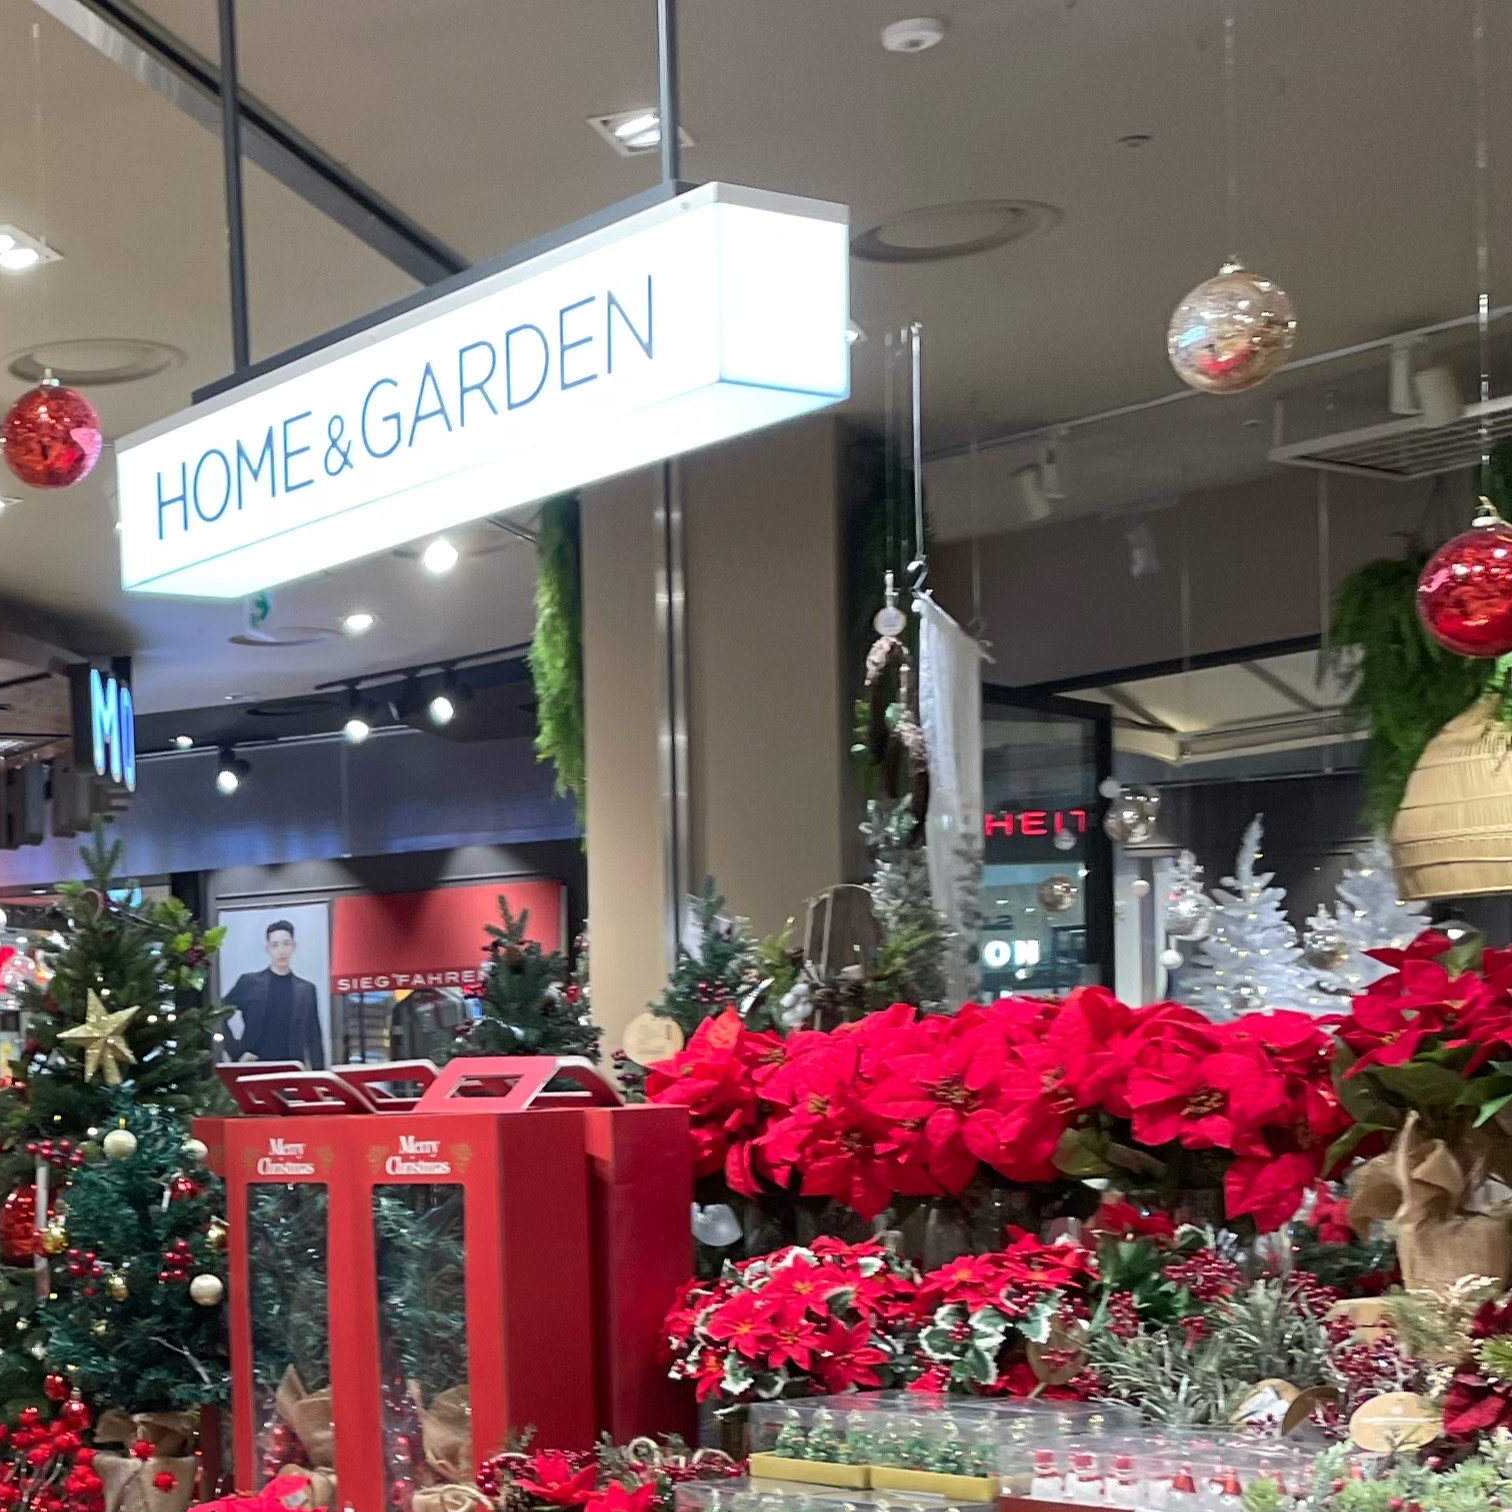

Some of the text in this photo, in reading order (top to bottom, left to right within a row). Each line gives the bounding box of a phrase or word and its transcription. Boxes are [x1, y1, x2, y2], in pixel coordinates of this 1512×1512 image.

[156, 274, 654, 540] HOME&GARDEN
[337, 975, 390, 991] SIEG
[268, 1138, 307, 1159] Merry
[398, 1135, 441, 1158] Merry
